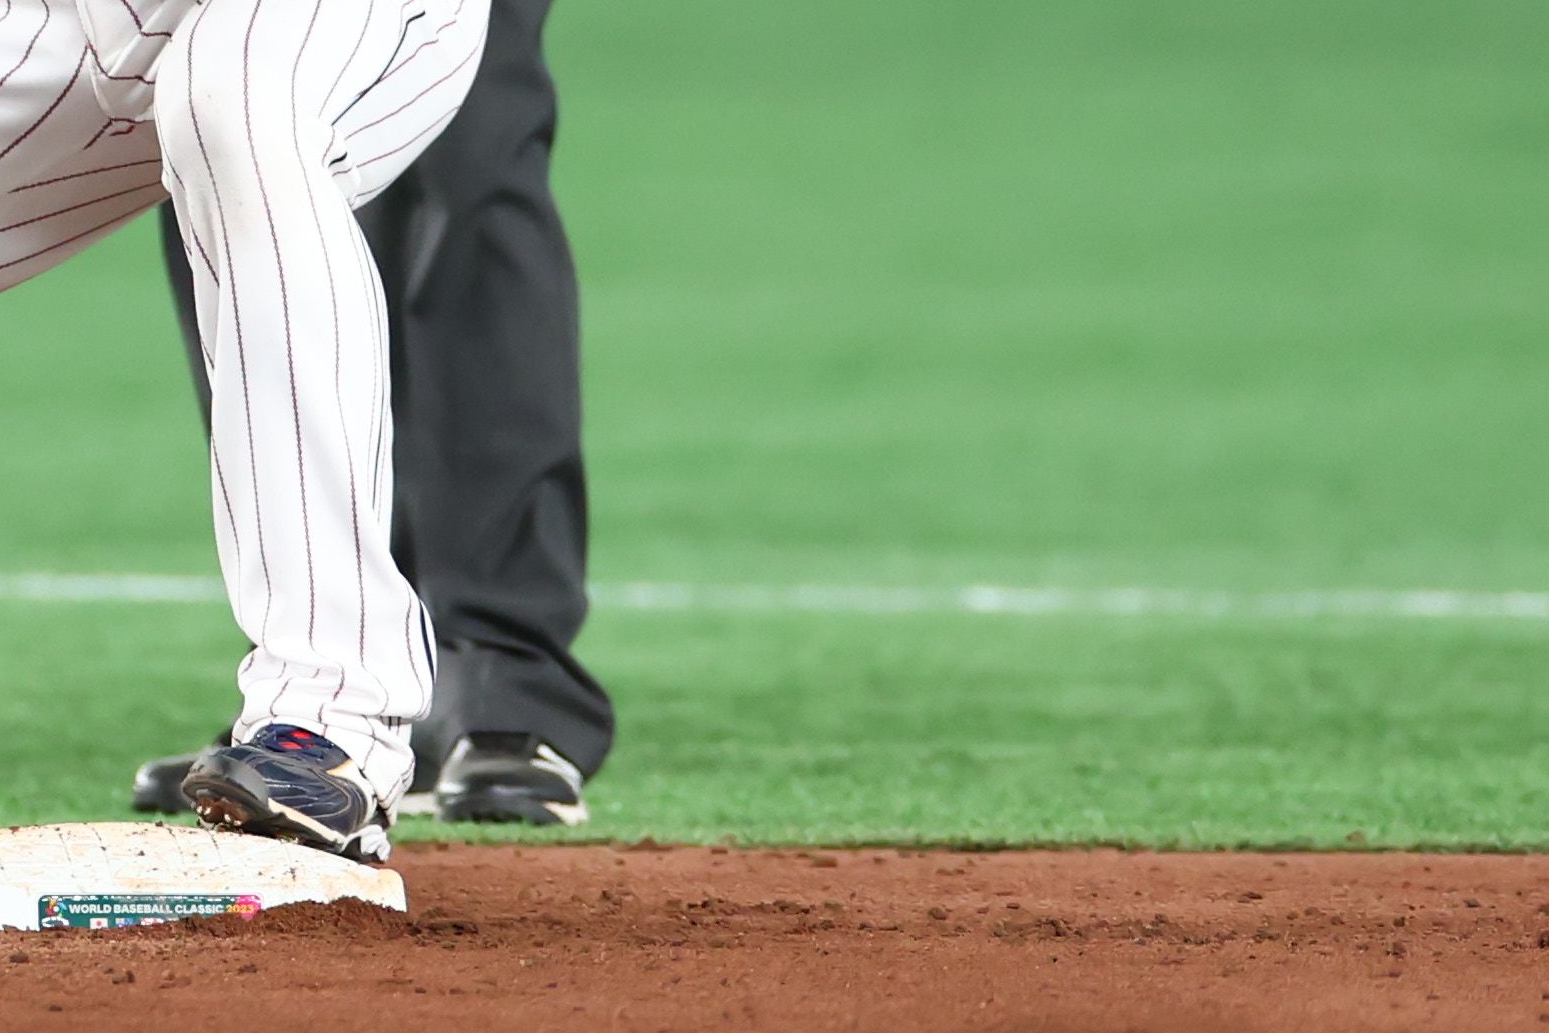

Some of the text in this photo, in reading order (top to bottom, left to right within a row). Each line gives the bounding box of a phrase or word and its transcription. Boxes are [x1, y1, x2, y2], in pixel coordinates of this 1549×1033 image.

[68, 904, 255, 914] WORLD BASEBALL CLASSIC 2023
